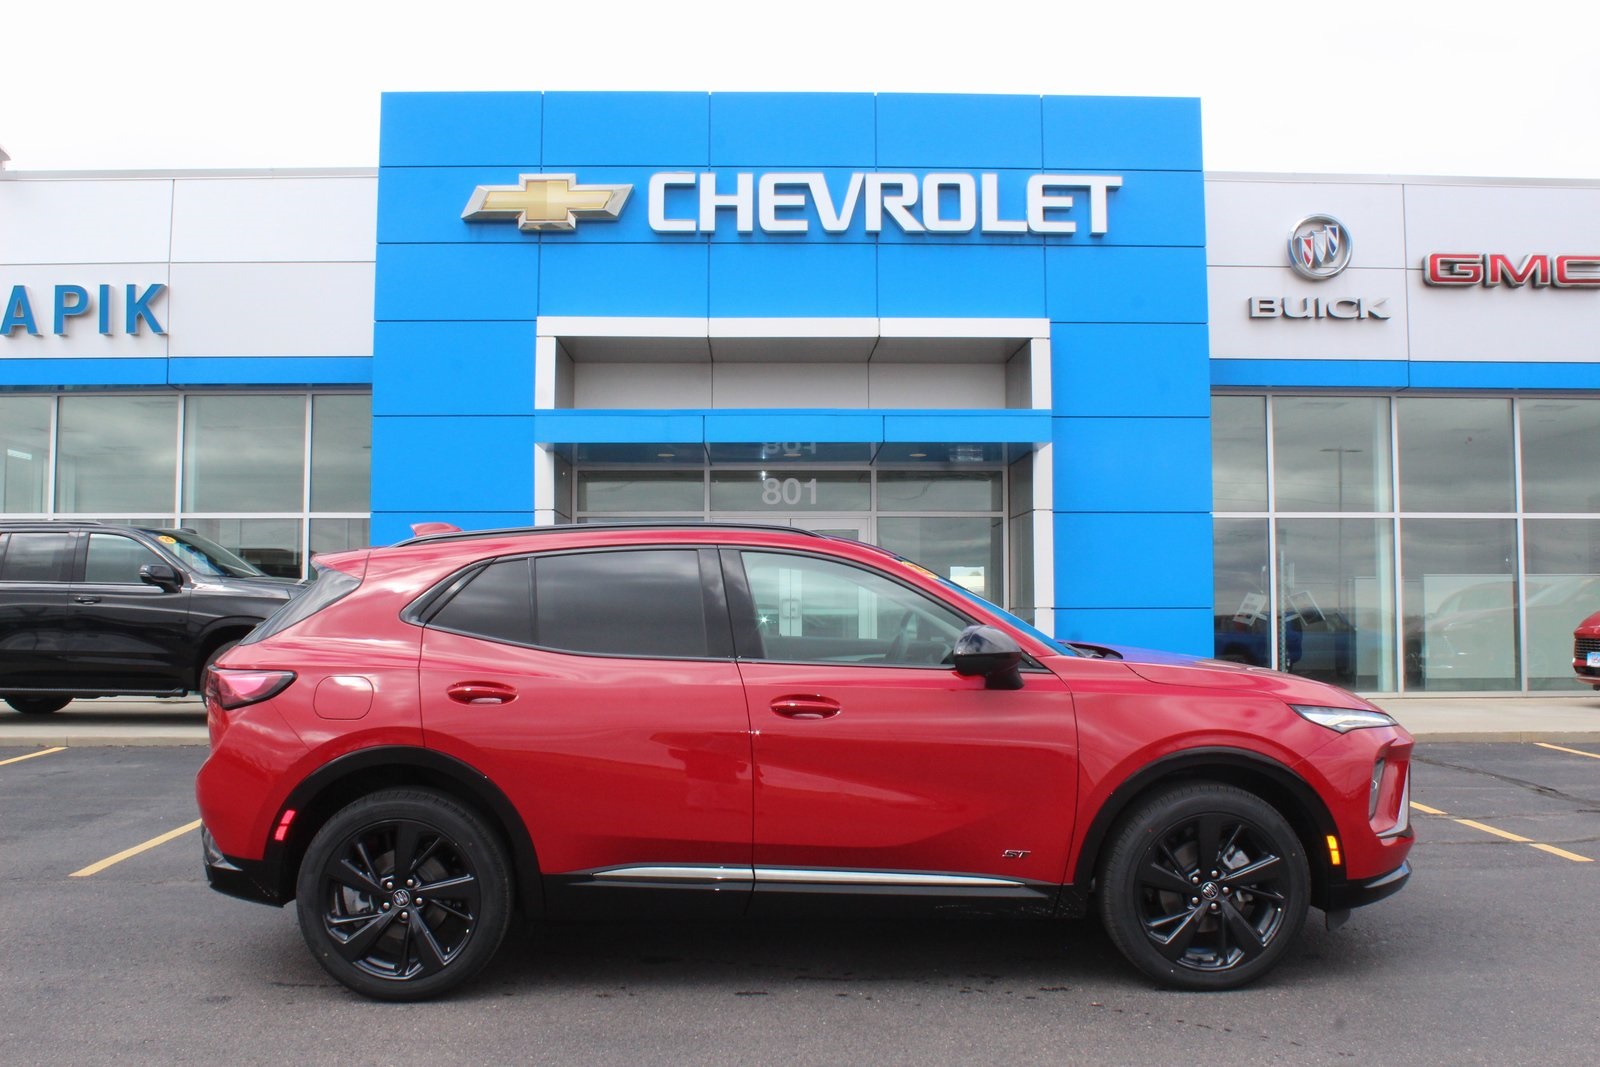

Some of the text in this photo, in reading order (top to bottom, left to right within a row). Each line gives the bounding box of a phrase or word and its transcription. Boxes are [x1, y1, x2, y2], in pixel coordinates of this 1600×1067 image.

[648, 172, 1123, 235] CHEVROLET
[1423, 253, 1600, 289] GMC
[0, 284, 168, 336] APIK
[1249, 297, 1391, 320] BUICK
[761, 477, 817, 505] 801
[1002, 849, 1031, 858] ST
